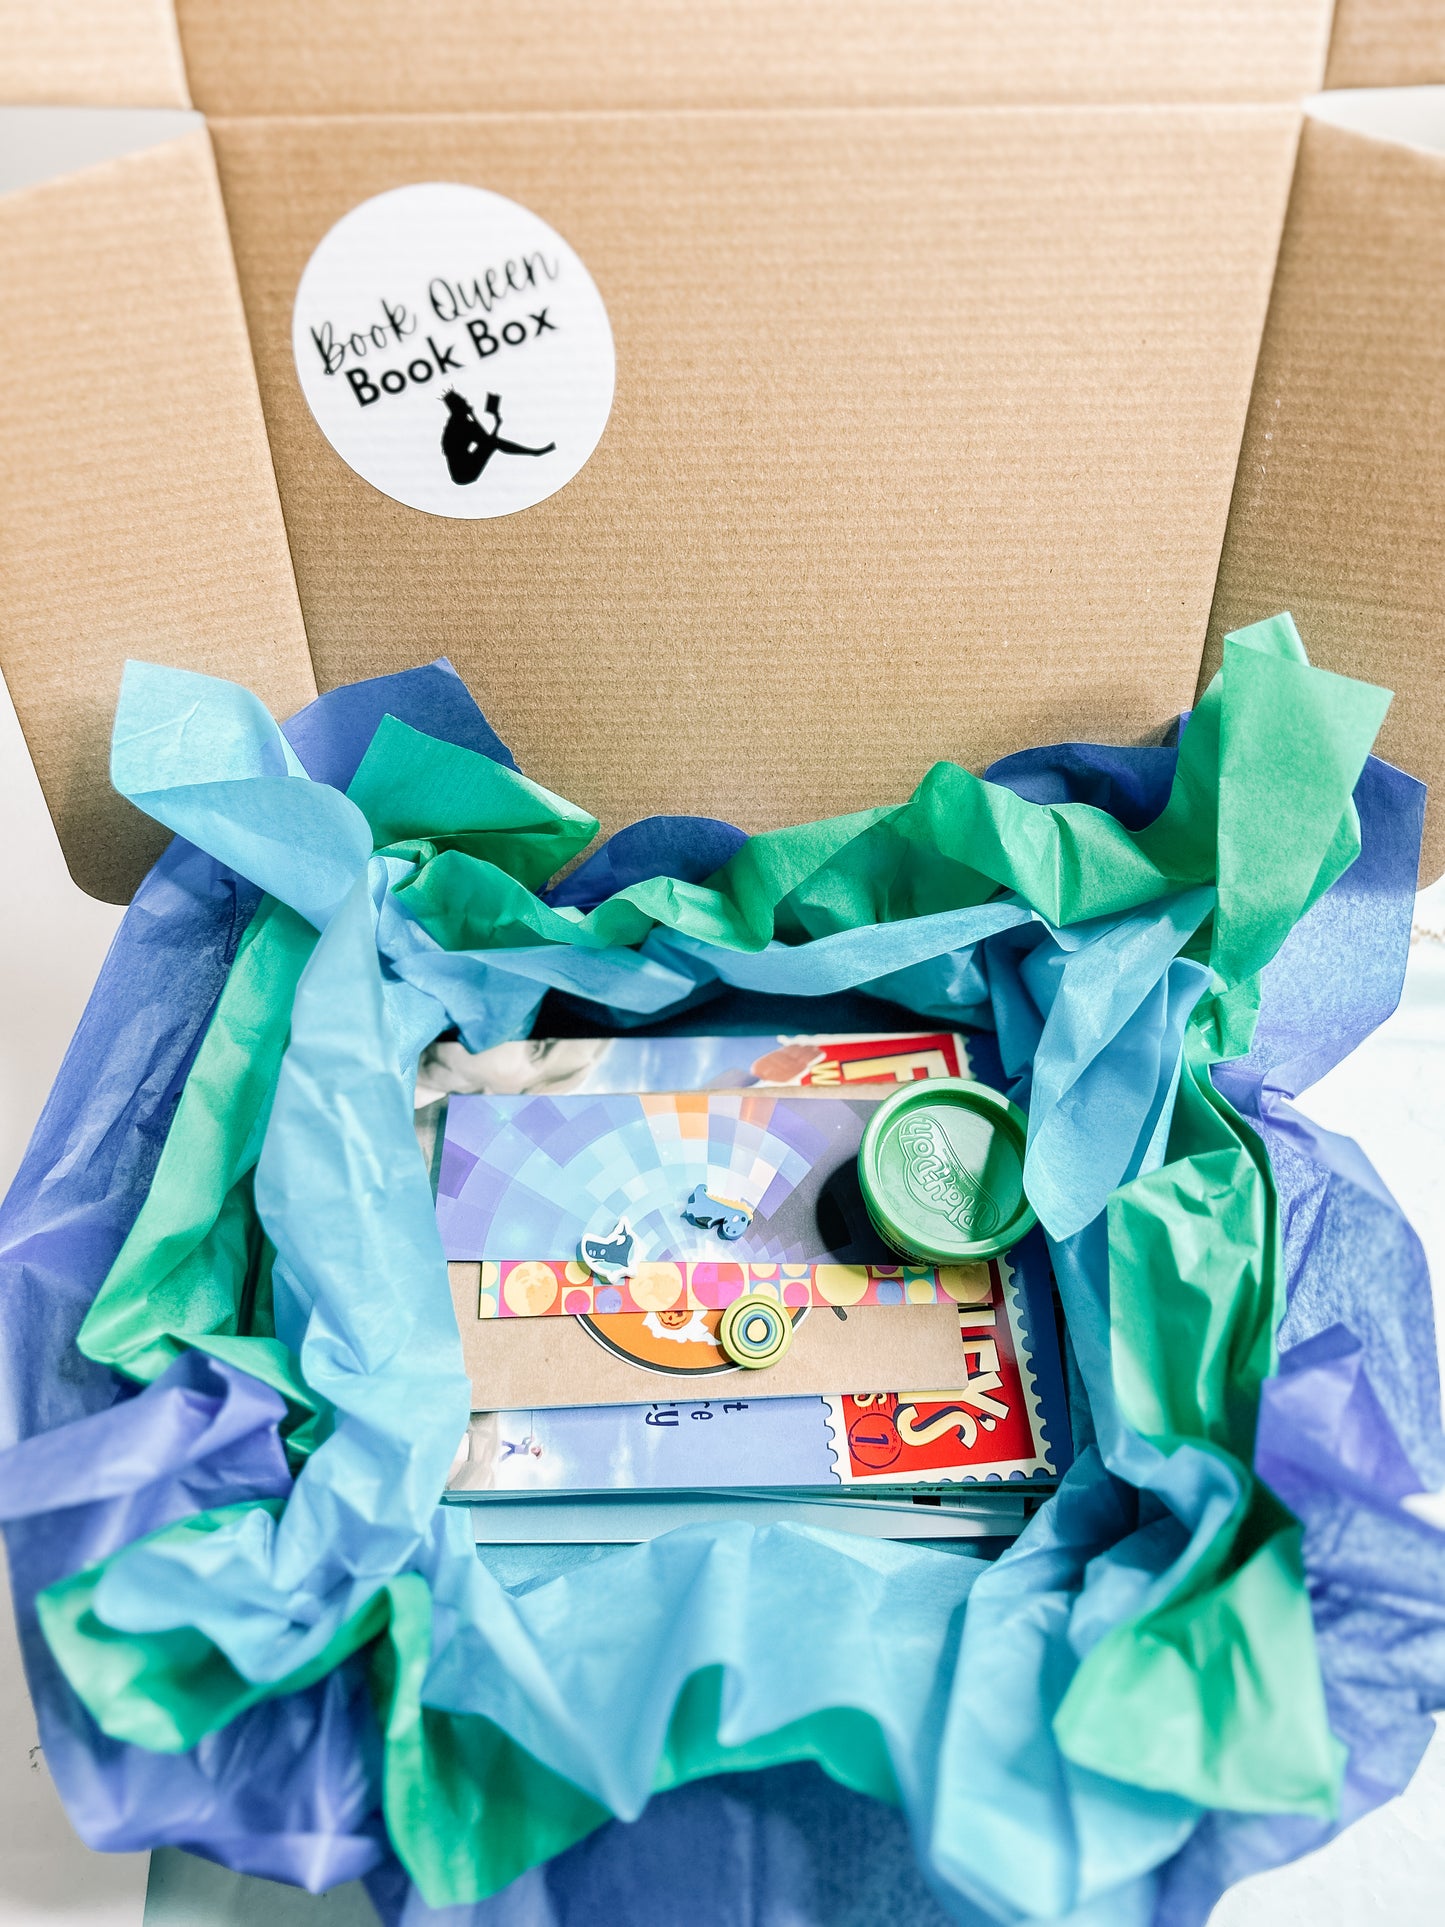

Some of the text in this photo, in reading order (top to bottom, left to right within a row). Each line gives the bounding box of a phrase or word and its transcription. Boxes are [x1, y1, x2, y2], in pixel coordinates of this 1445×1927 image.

[310, 251, 559, 375] Book Queen
[345, 307, 558, 407] Book Box
[901, 1117, 989, 1232] Play-Doh
